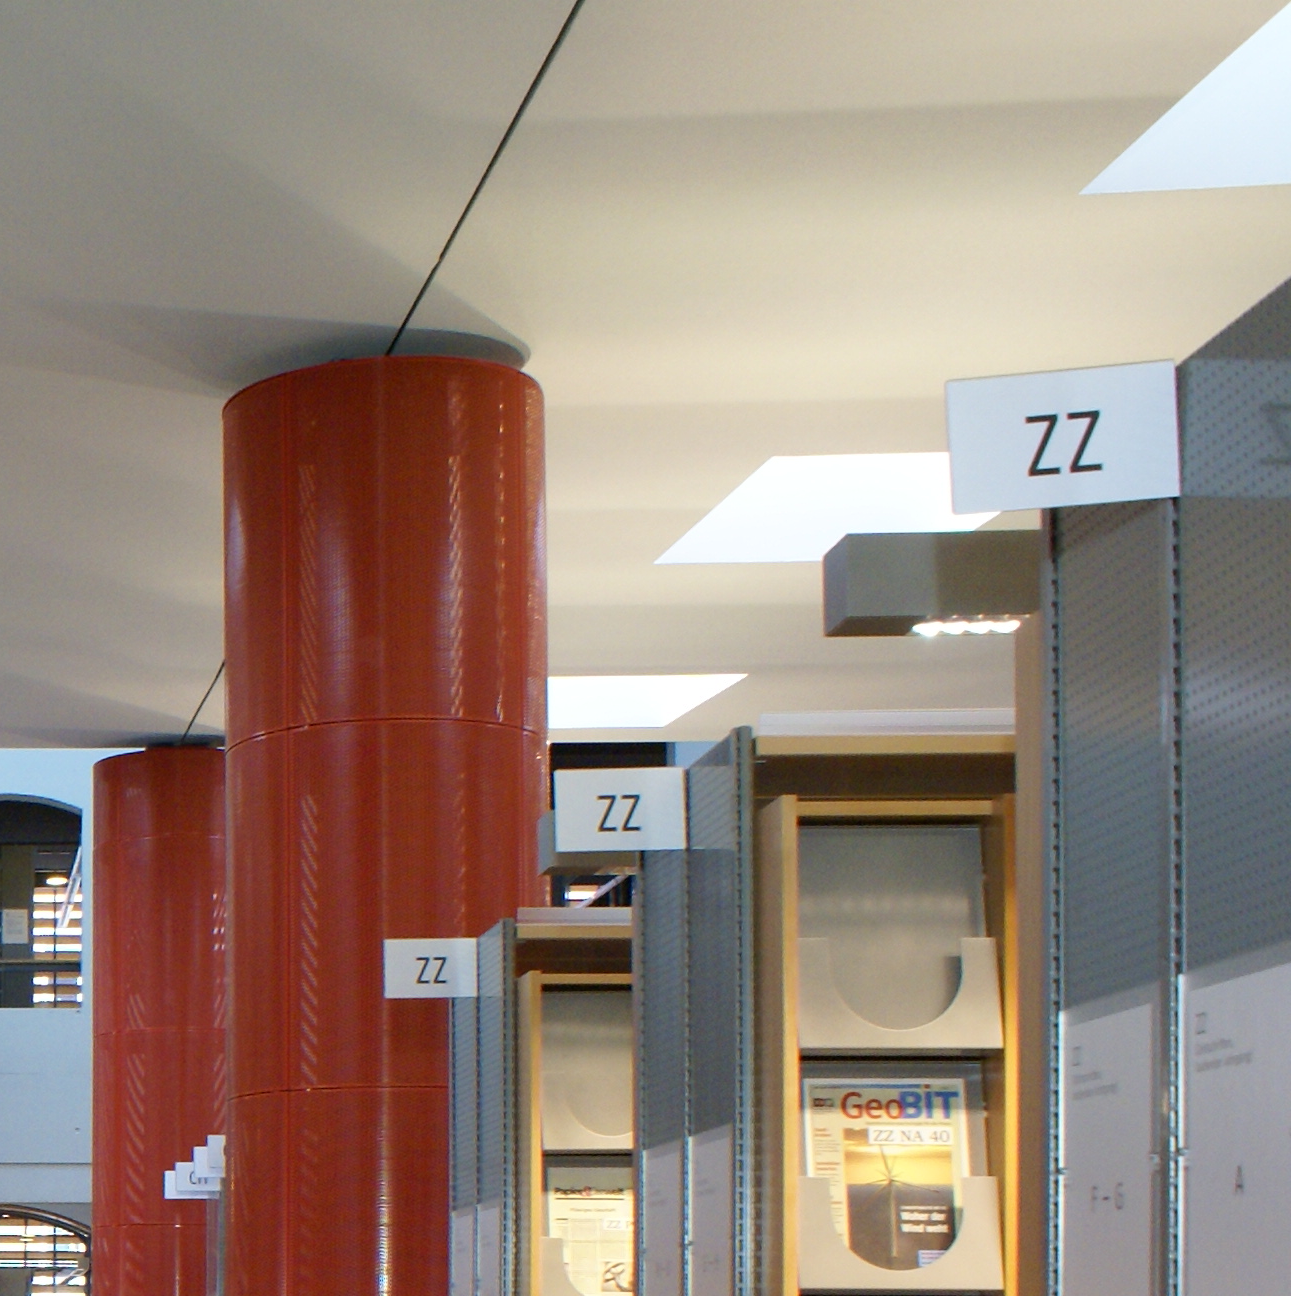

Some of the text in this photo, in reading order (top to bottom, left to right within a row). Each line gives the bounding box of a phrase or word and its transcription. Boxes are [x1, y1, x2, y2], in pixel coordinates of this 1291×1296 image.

[1025, 409, 1103, 477] ZZ
[596, 794, 641, 832] ZZ
[415, 956, 447, 984] ZZ
[873, 1129, 951, 1143] ZZ NA 40
[1234, 1165, 1244, 1196] A
